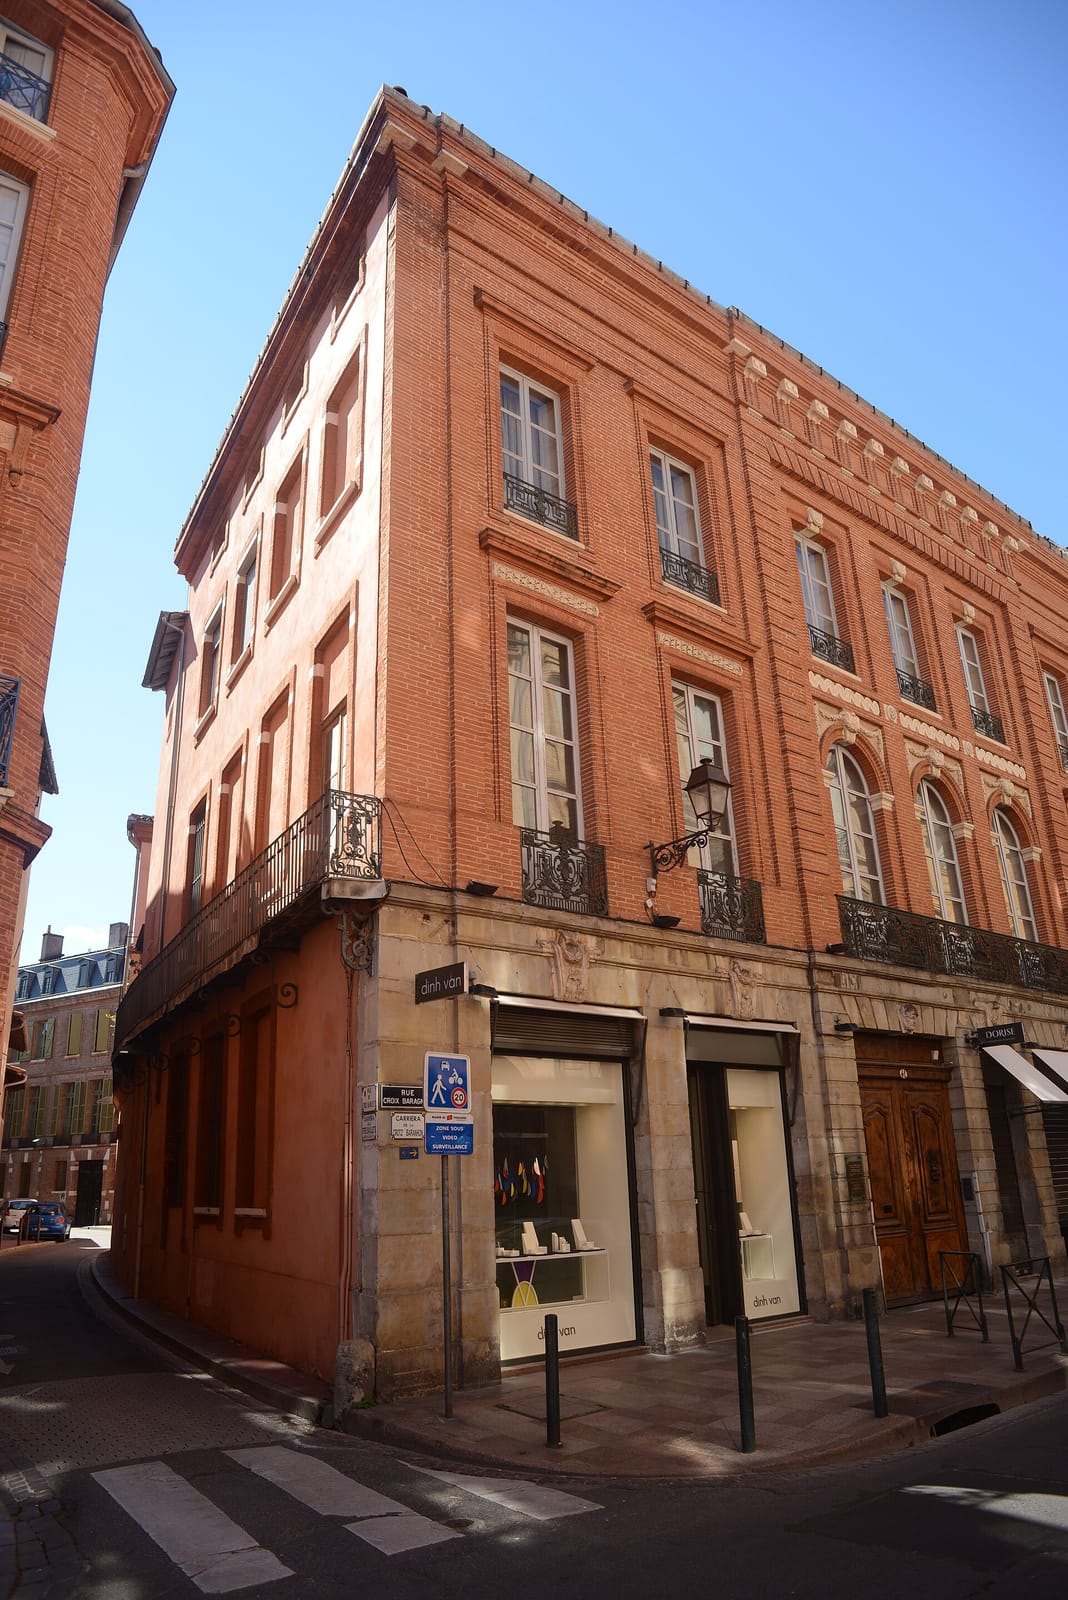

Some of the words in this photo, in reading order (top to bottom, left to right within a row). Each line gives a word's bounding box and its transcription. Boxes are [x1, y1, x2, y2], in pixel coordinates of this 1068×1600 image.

[421, 976, 441, 995] dinh
[443, 976, 462, 990] van
[401, 1089, 415, 1097] RUE
[454, 1093, 464, 1102] 20
[383, 1097, 400, 1105] CROIX
[753, 1295, 768, 1308] dinh
[769, 1296, 782, 1305] van
[558, 1326, 577, 1337] van
